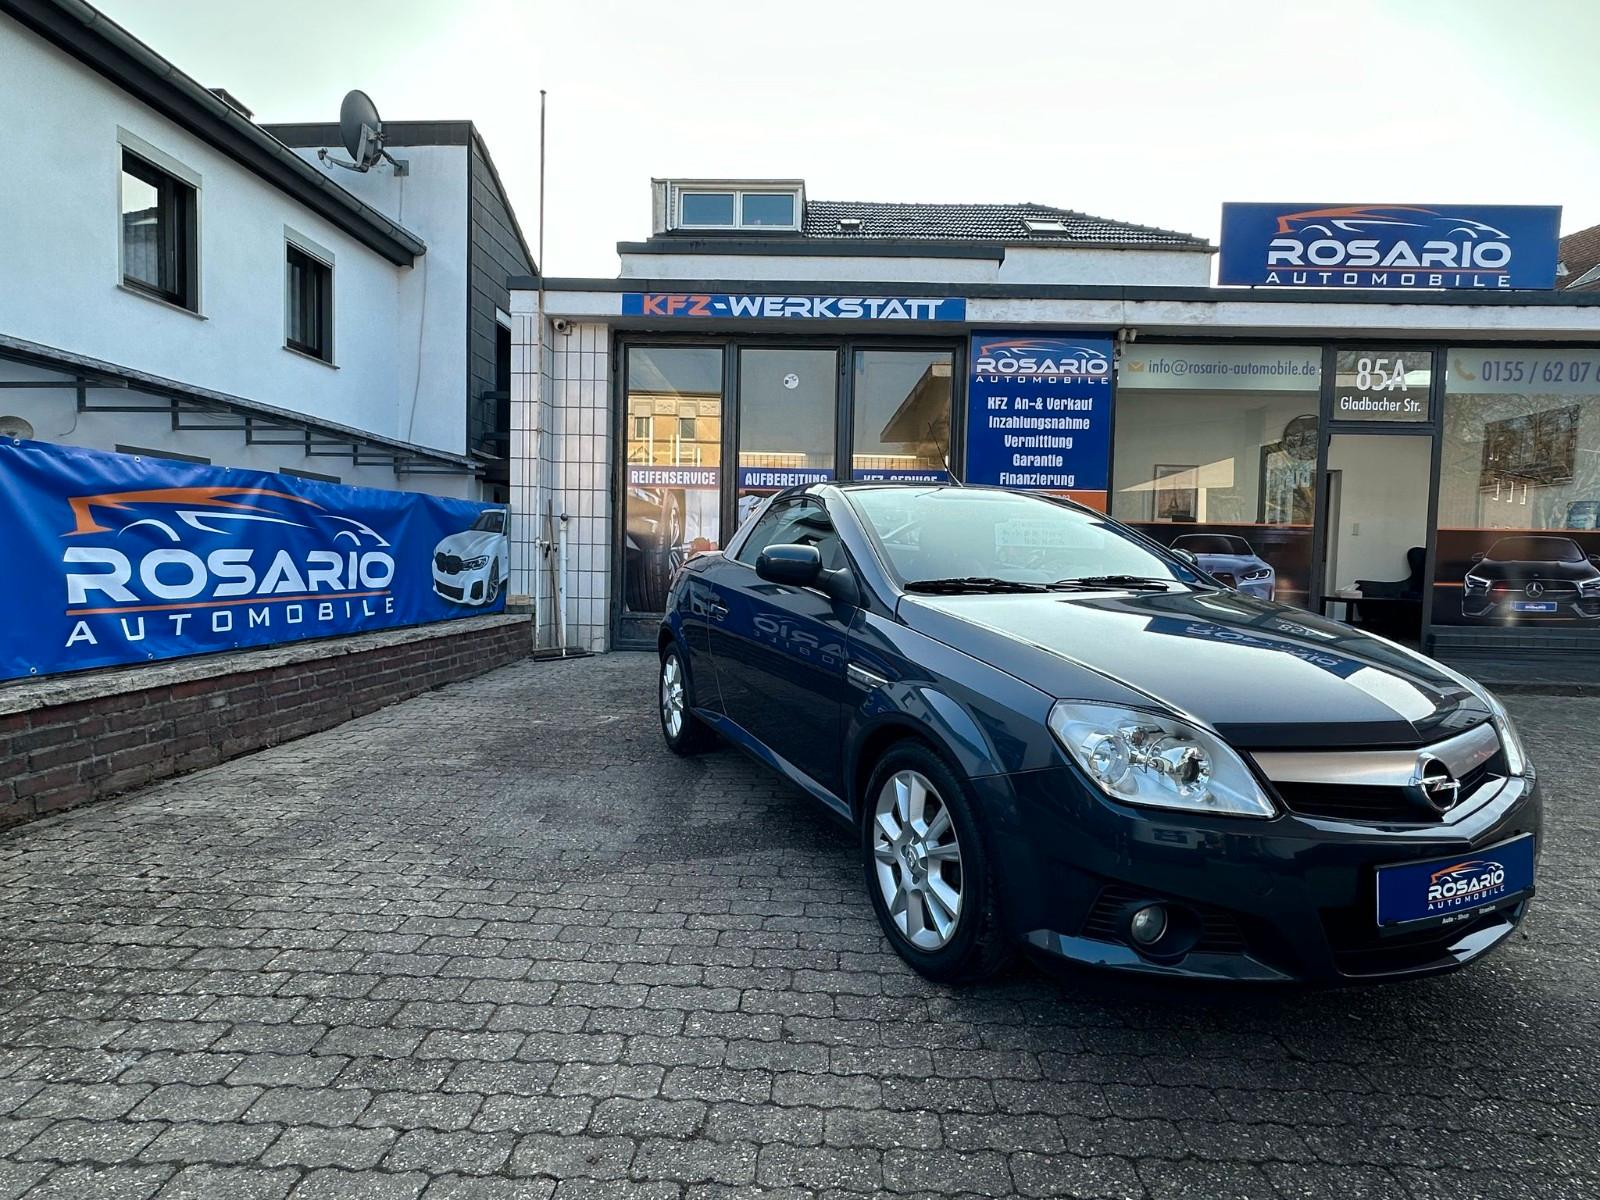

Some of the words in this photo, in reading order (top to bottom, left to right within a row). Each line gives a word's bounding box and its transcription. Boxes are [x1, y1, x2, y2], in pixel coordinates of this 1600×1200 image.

[1267, 238, 1512, 268] ROSARIO
[1265, 271, 1510, 287] AUTOMOBILE
[643, 295, 944, 320] KFZ-WERKSTATT
[976, 358, 1108, 374] ROSARIO
[1149, 358, 1315, 376] info@rosario-automobile.de
[1482, 361, 1524, 382] 0155
[1543, 361, 1564, 382] 62
[1569, 362, 1591, 382] 07
[976, 375, 1108, 385] AUTOMOBILE
[1356, 358, 1407, 391] 85A
[987, 397, 1008, 410] KFZ
[1046, 397, 1093, 411] Verkauf
[1340, 396, 1401, 411] Gladbacher
[1404, 398, 1421, 412] Str.
[988, 416, 1090, 430] Inzahlungsnahme
[1004, 434, 1073, 449] Vermittlung
[1012, 454, 1063, 467] Garantie
[631, 470, 716, 485] REIFENSERVICE
[999, 472, 1075, 487] Finanzierung
[62, 547, 395, 604] ROSARIO
[65, 597, 394, 647] AUTOMOBILE
[1428, 869, 1505, 901] ROSARIO
[1428, 886, 1505, 911] AUTOMOBILE
